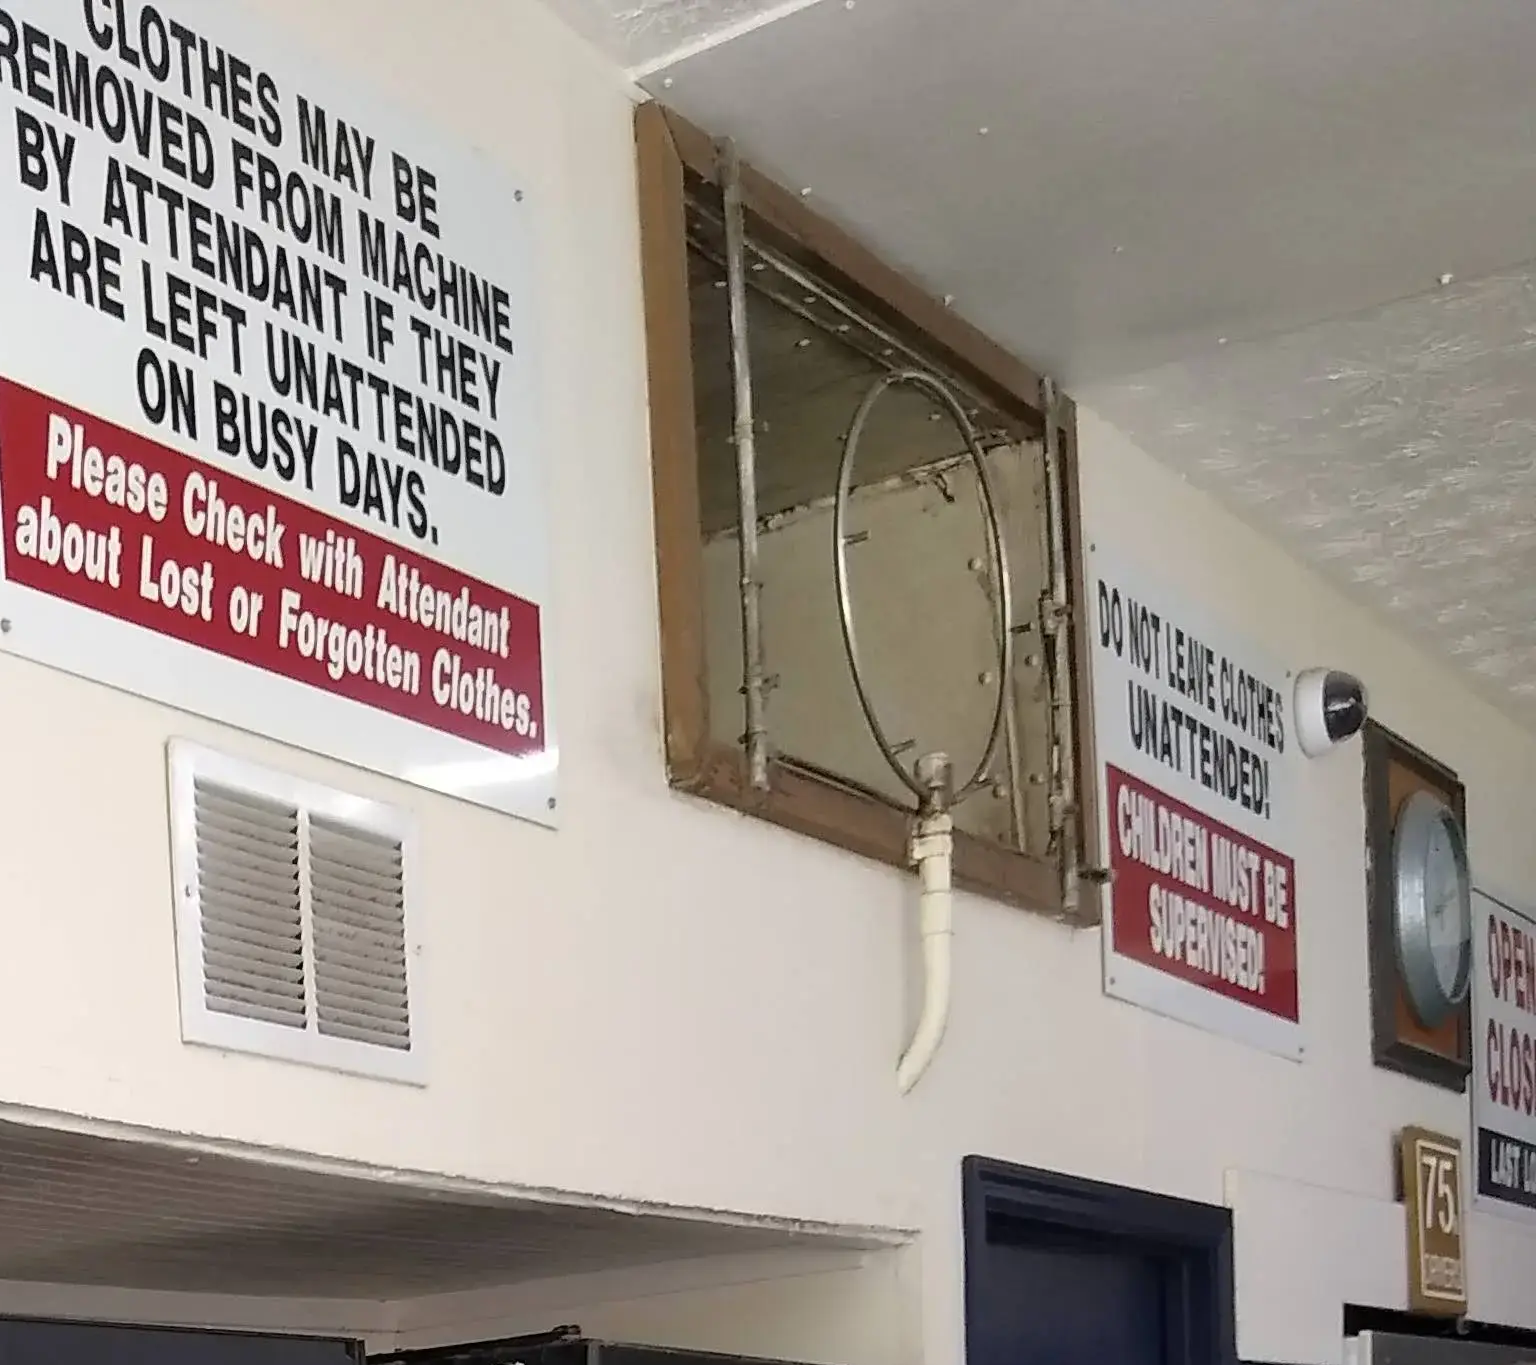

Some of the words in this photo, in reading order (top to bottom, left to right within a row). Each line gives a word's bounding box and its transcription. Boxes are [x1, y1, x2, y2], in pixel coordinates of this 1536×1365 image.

[84, 0, 283, 149] CLOTHES
[297, 94, 375, 199] MAY
[392, 150, 440, 239] BE
[15, 108, 76, 206] BY
[103, 158, 346, 341] ATTENDANT
[365, 291, 395, 364] IF
[410, 316, 500, 420] THEY
[233, 139, 346, 262] FROM
[359, 209, 514, 355] MACHINE
[30, 208, 125, 319] ARE
[142, 258, 246, 373] LEFT
[265, 320, 506, 497] UNATTENDED
[136, 348, 197, 439] ON
[216, 383, 320, 491] BUSY
[338, 439, 439, 545] DAYS.
[15, 498, 122, 588] about
[139, 534, 215, 621] Lost
[229, 586, 263, 636] or
[278, 591, 420, 695] Forgotten
[431, 647, 538, 739] Clothes.
[45, 412, 169, 522] Please
[183, 472, 285, 569] Check
[299, 528, 364, 600] with
[378, 553, 510, 658] Attendant
[1098, 579, 1123, 657] DO
[1128, 598, 1160, 679] NOT
[1166, 622, 1215, 713] LEAVE
[1220, 657, 1284, 754] CLOTHES
[1128, 680, 1270, 820] UNATTENDED!
[1117, 784, 1209, 893] CHILDREN
[1212, 832, 1260, 916] MUST
[1264, 859, 1288, 928] BE
[1149, 883, 1264, 994] SUPERVISED!
[1487, 1018, 1536, 1116] CLOS
